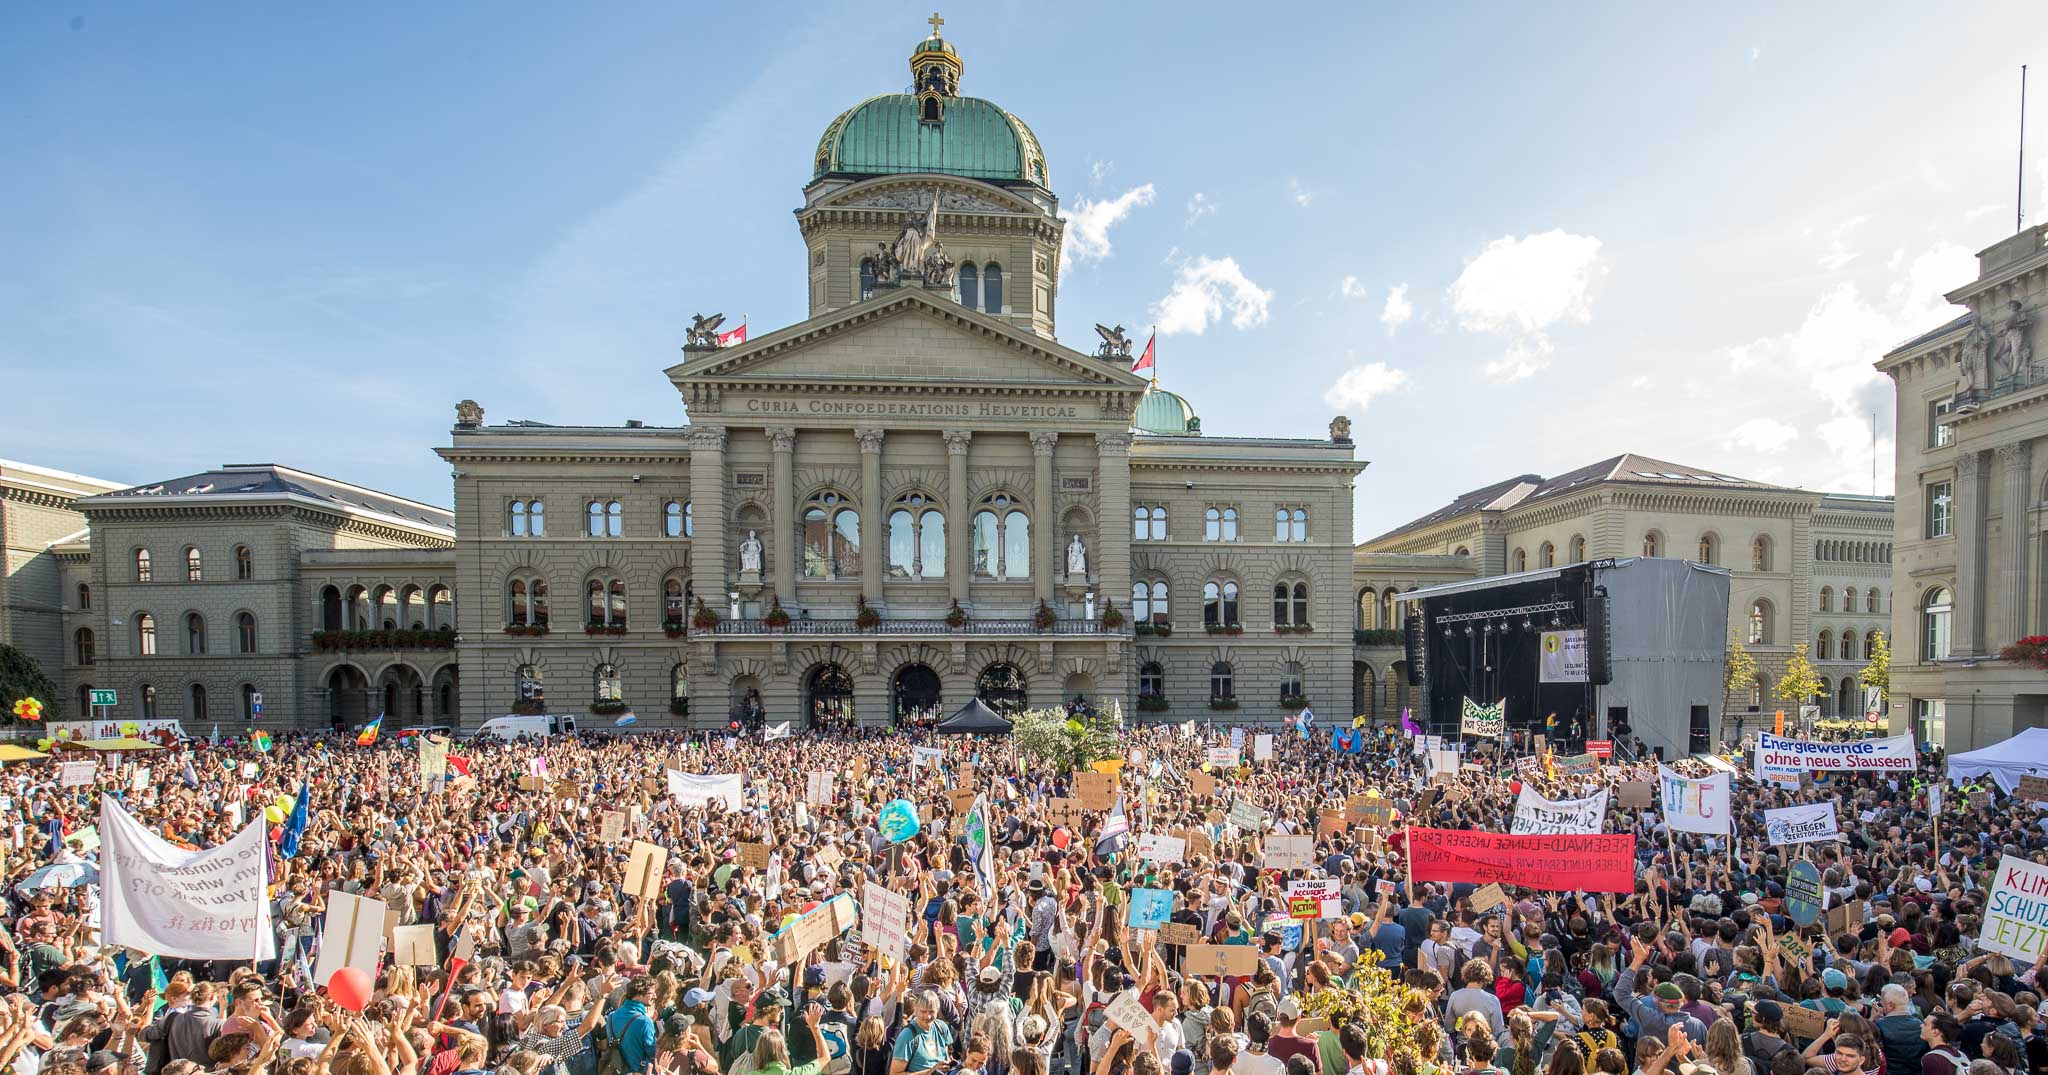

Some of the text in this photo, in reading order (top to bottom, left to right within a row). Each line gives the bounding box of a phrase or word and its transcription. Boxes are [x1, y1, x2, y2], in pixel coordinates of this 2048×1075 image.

[747, 399, 1077, 418] CURIA CONFOEDERATIONIS HELVETICAE
[1761, 734, 1873, 754] Energiewende
[1764, 751, 1912, 768] ohne neue Stauseen
[1790, 821, 1826, 834] FLIEGEN
[1307, 881, 1326, 889] NOUS
[1292, 902, 1317, 914] ACTION
[1988, 915, 2048, 957] JETZT
